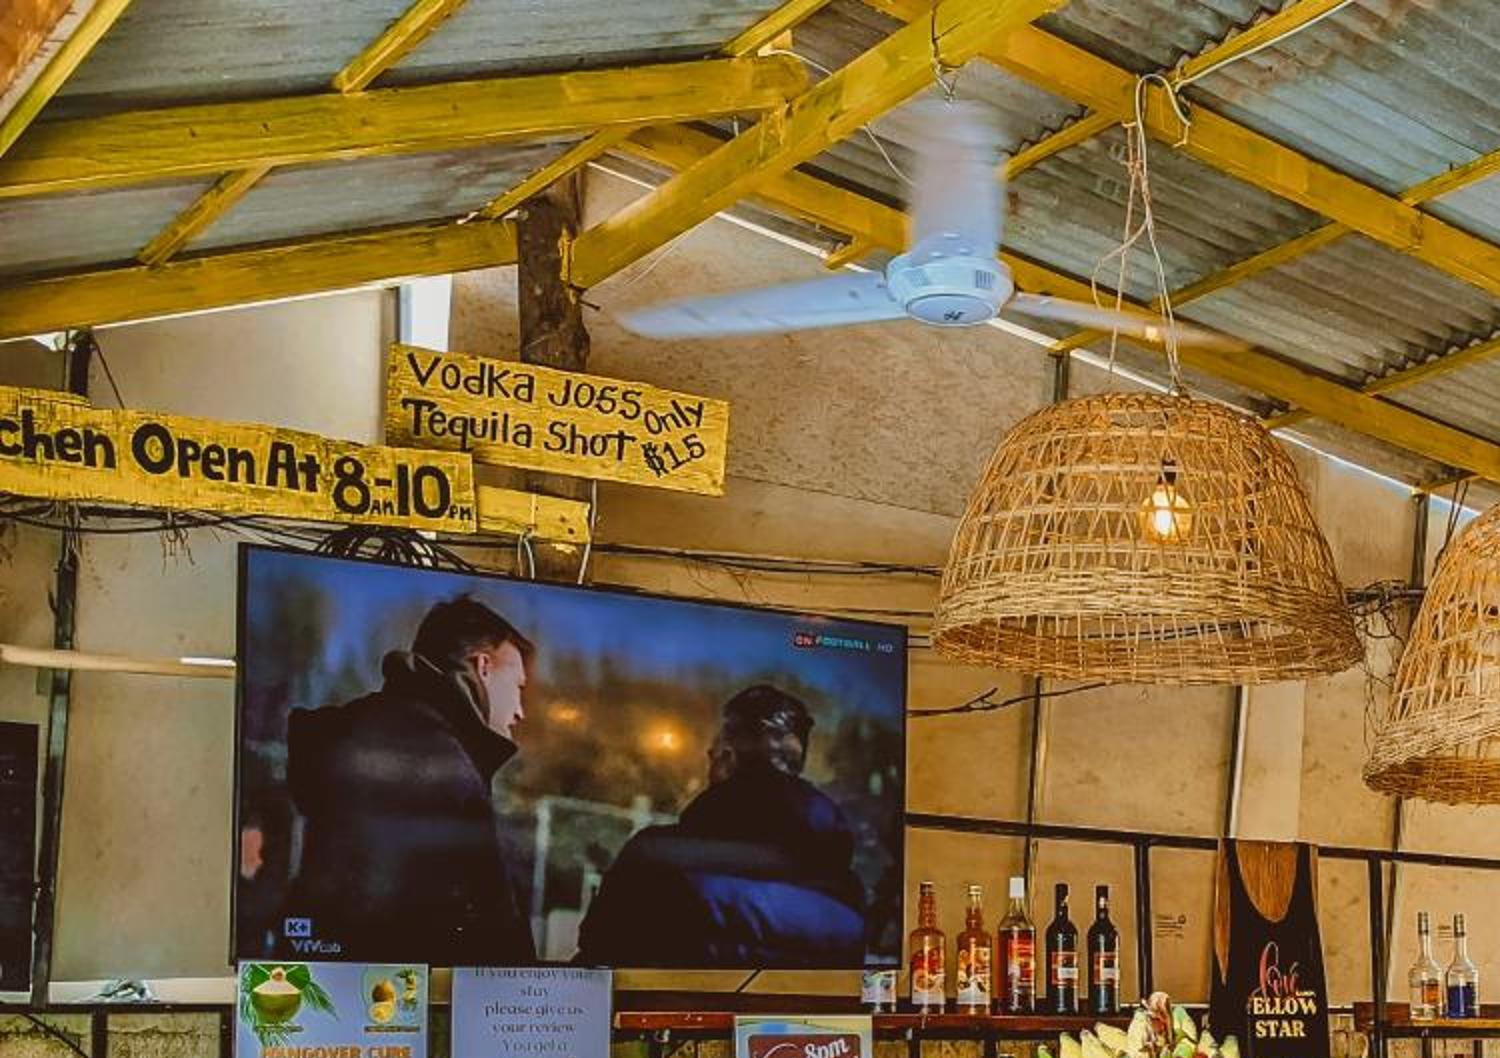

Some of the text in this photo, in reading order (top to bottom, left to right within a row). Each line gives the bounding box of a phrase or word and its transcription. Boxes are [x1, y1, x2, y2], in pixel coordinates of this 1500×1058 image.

[402, 397, 533, 452] Tequila
[131, 421, 257, 486] Open
[265, 441, 321, 492] At
[519, 985, 551, 998] stay
[484, 1000, 585, 1018] please give us
[1247, 997, 1317, 1015] ELLOW
[492, 1021, 577, 1035] your review
[1255, 1019, 1306, 1038] STAR
